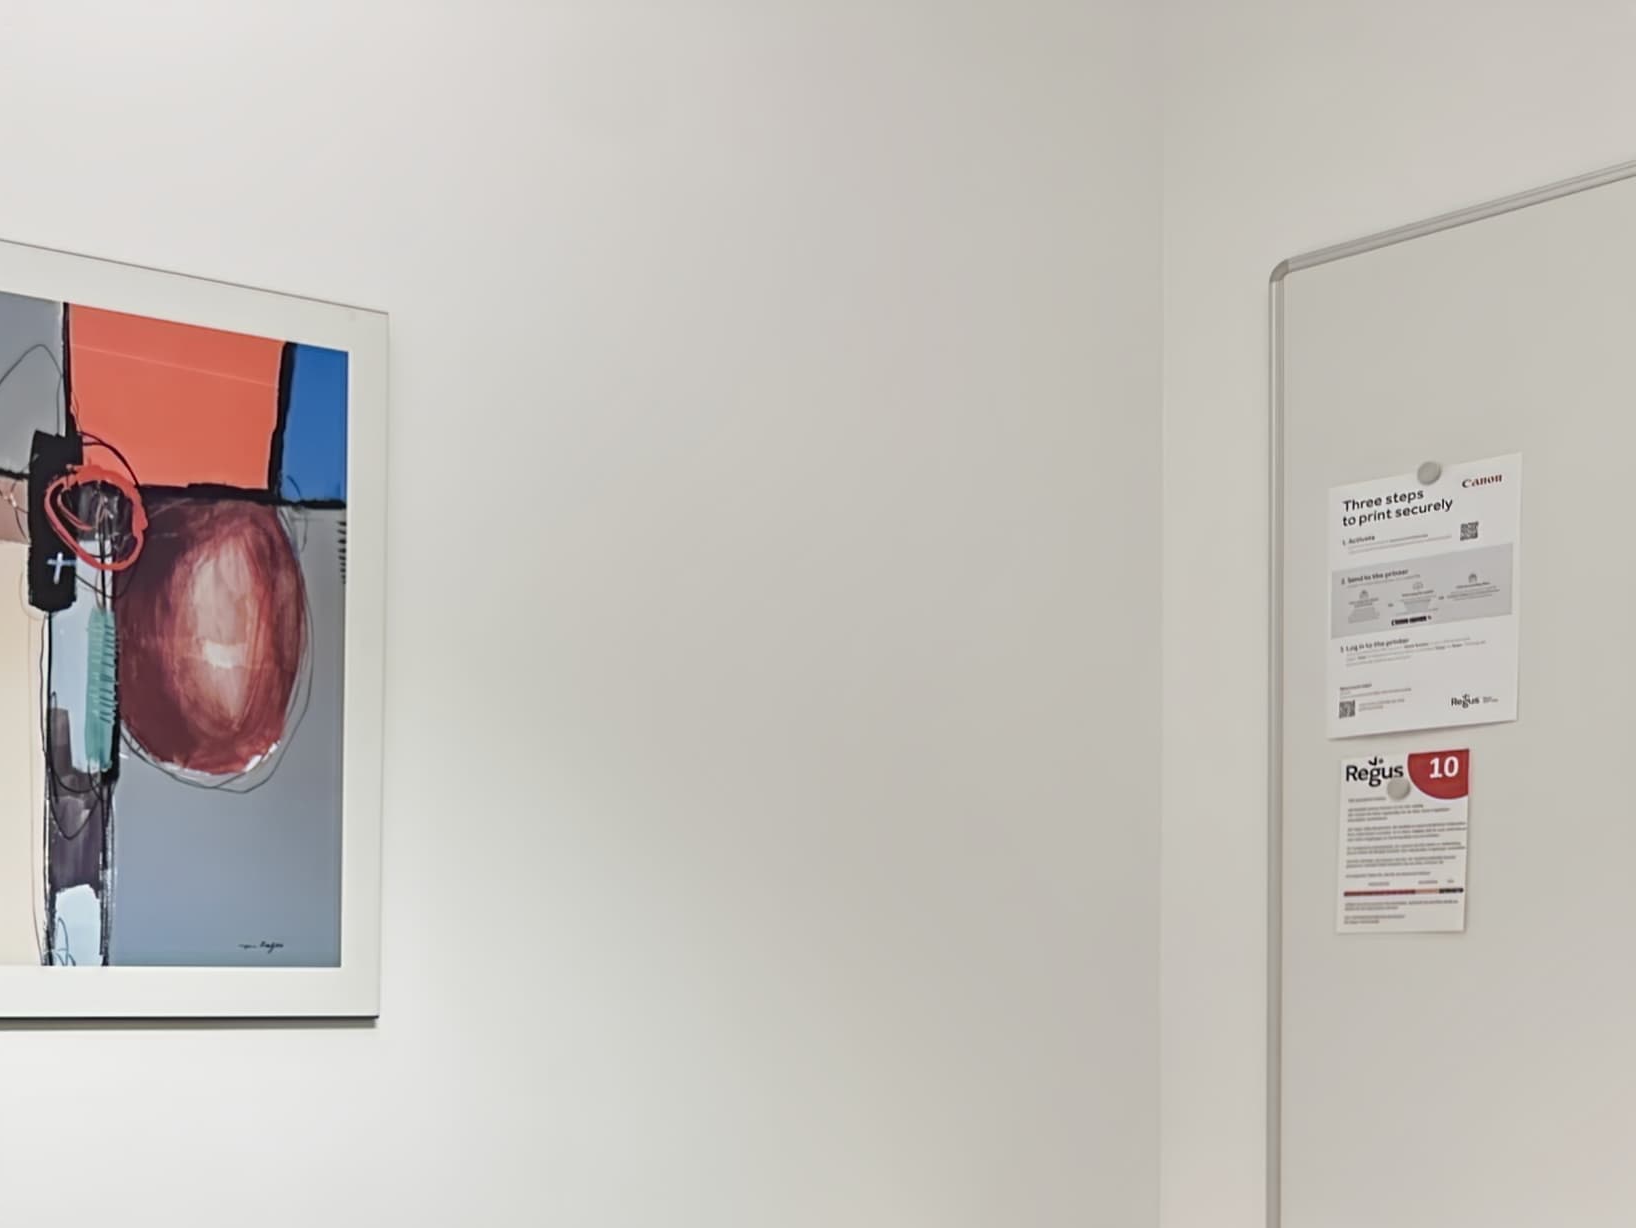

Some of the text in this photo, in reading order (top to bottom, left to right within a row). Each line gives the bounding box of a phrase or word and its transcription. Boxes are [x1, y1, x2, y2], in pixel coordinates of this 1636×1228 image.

[1462, 474, 1503, 488] Canon
[1342, 490, 1424, 512] Three steps
[1342, 499, 1454, 527] to print securely
[1345, 758, 1404, 787] Regus
[1429, 756, 1459, 779] 10
